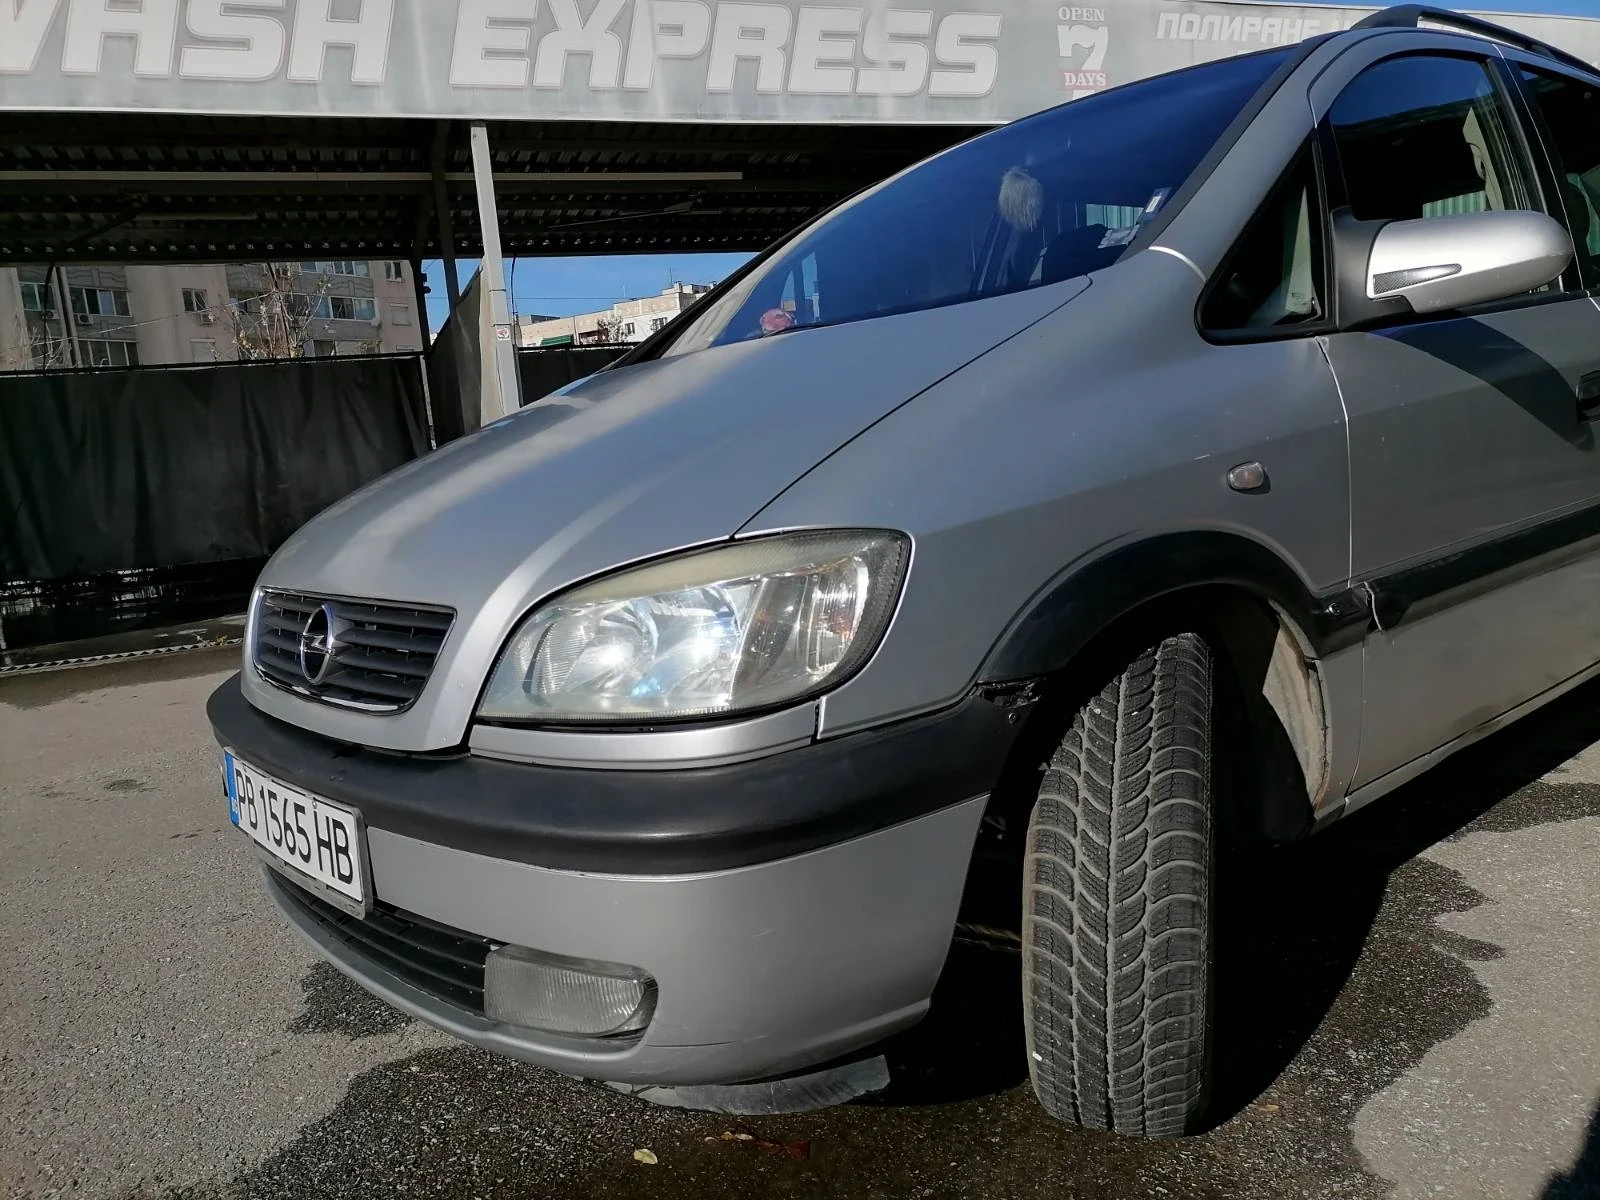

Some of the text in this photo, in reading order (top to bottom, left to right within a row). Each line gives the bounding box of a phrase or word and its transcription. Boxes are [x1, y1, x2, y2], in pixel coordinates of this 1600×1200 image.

[448, 0, 1001, 96] EXPRESS
[1058, 6, 1105, 22] OPEN
[1056, 24, 1108, 100] 7
[1063, 72, 1106, 87] DAYS
[260, 784, 311, 864] 1565
